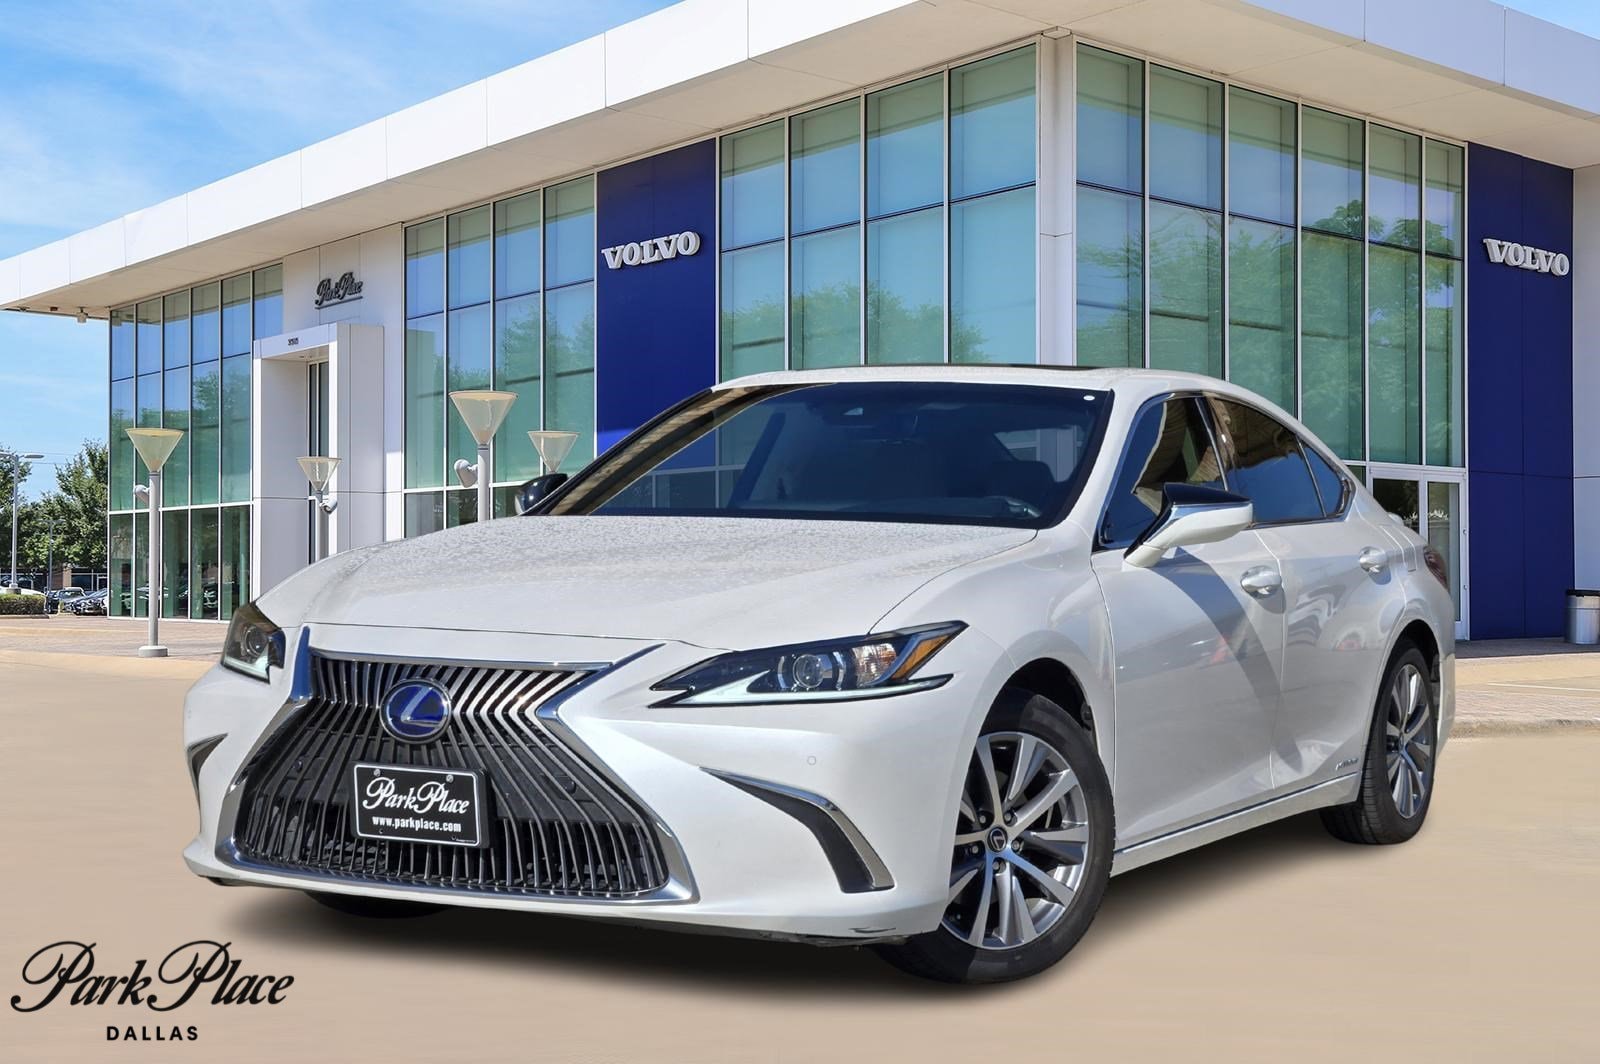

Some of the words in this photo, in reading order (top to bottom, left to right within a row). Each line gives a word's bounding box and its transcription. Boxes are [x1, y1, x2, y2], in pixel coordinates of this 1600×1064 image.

[601, 231, 701, 270] VOLVO
[1483, 238, 1570, 276] VOLVO
[362, 776, 417, 810] Park
[413, 781, 470, 814] Place
[372, 816, 462, 833] www.parkplace.com
